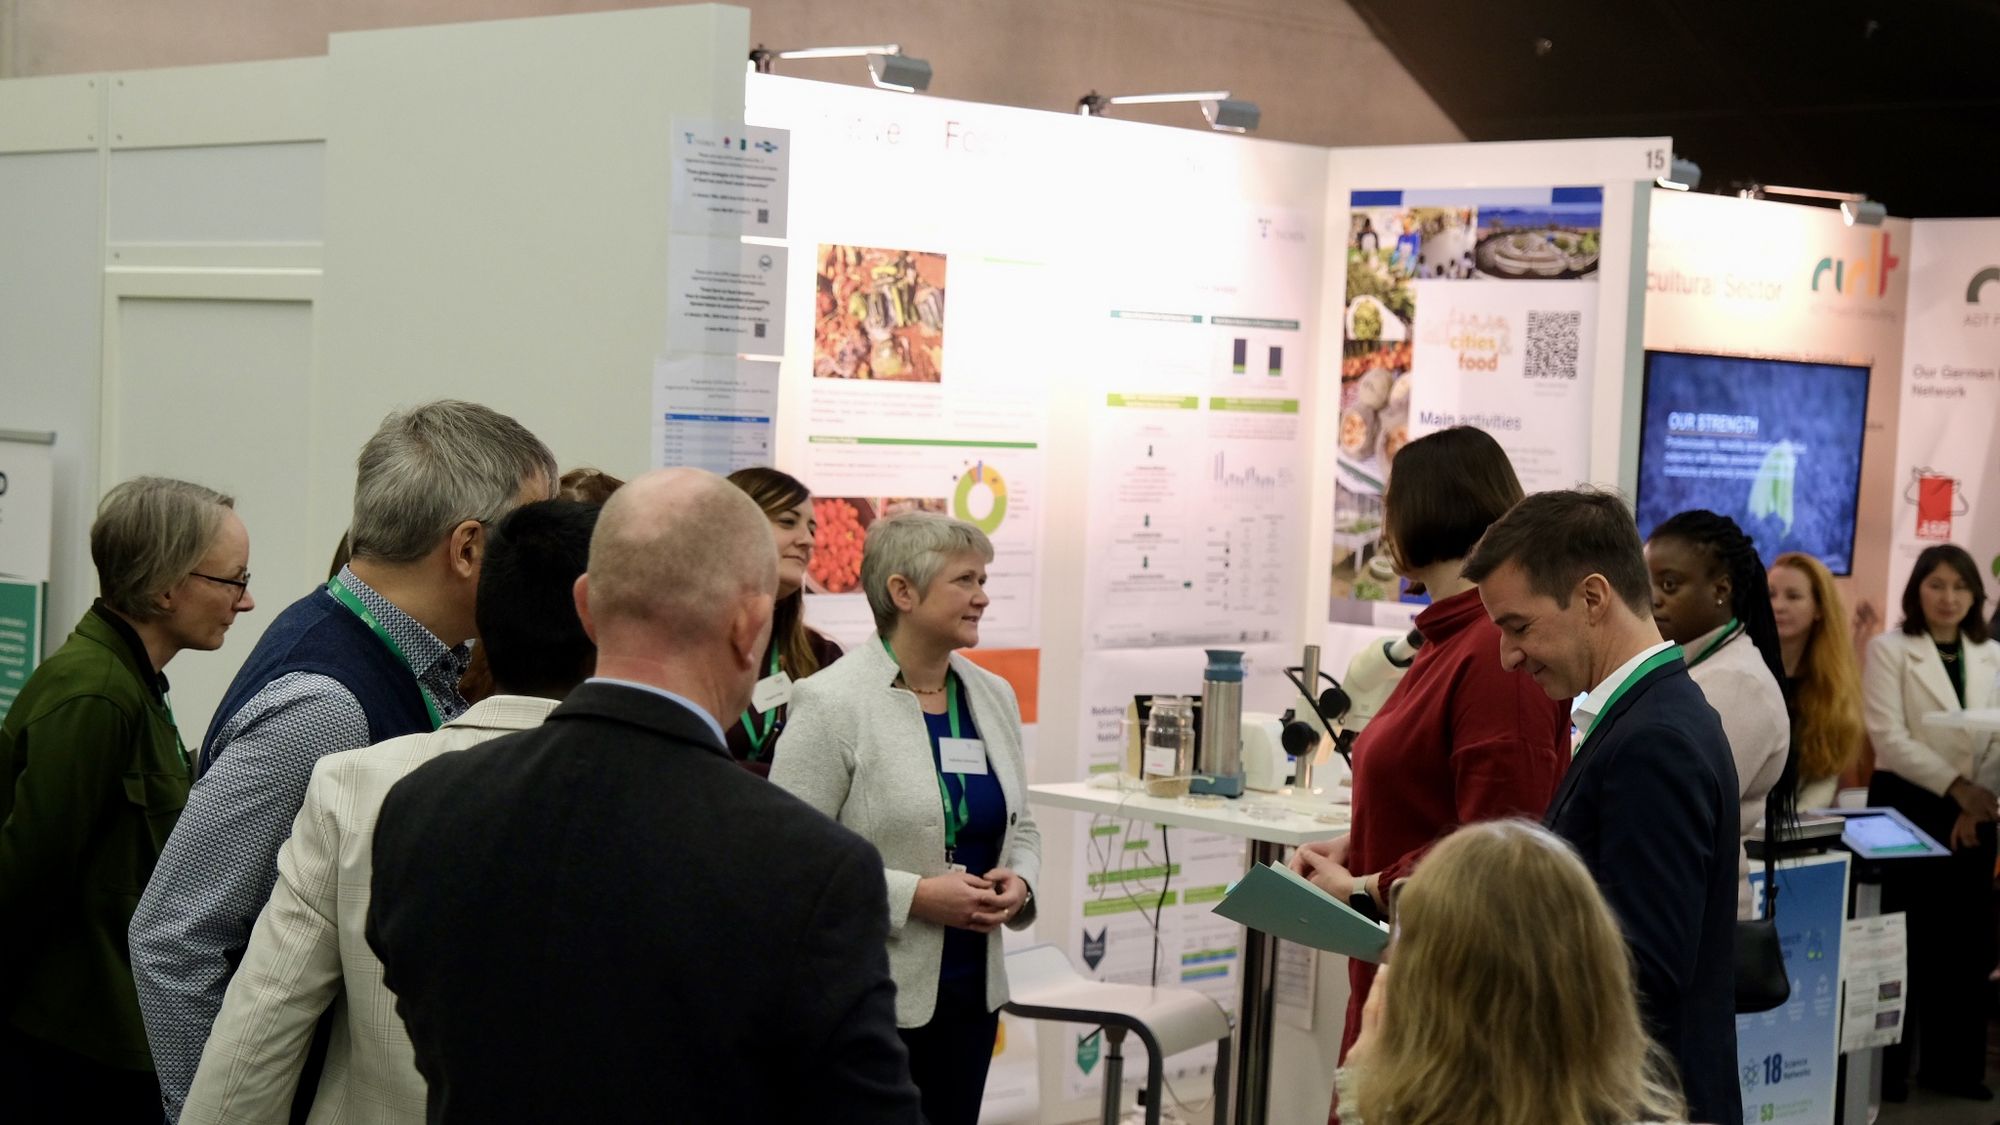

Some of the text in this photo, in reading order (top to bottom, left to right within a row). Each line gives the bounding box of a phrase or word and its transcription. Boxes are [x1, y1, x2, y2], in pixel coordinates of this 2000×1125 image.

[1646, 149, 1665, 169] 15
[1725, 273, 1783, 300] Sector
[1449, 331, 1497, 350] cities
[1458, 352, 1499, 371] food
[1913, 364, 1937, 379] Our
[1912, 383, 1967, 398] Network
[1420, 411, 1522, 430] Main activities
[1668, 411, 1759, 434] OUR STRENGTH
[1763, 1053, 1782, 1085] 18
